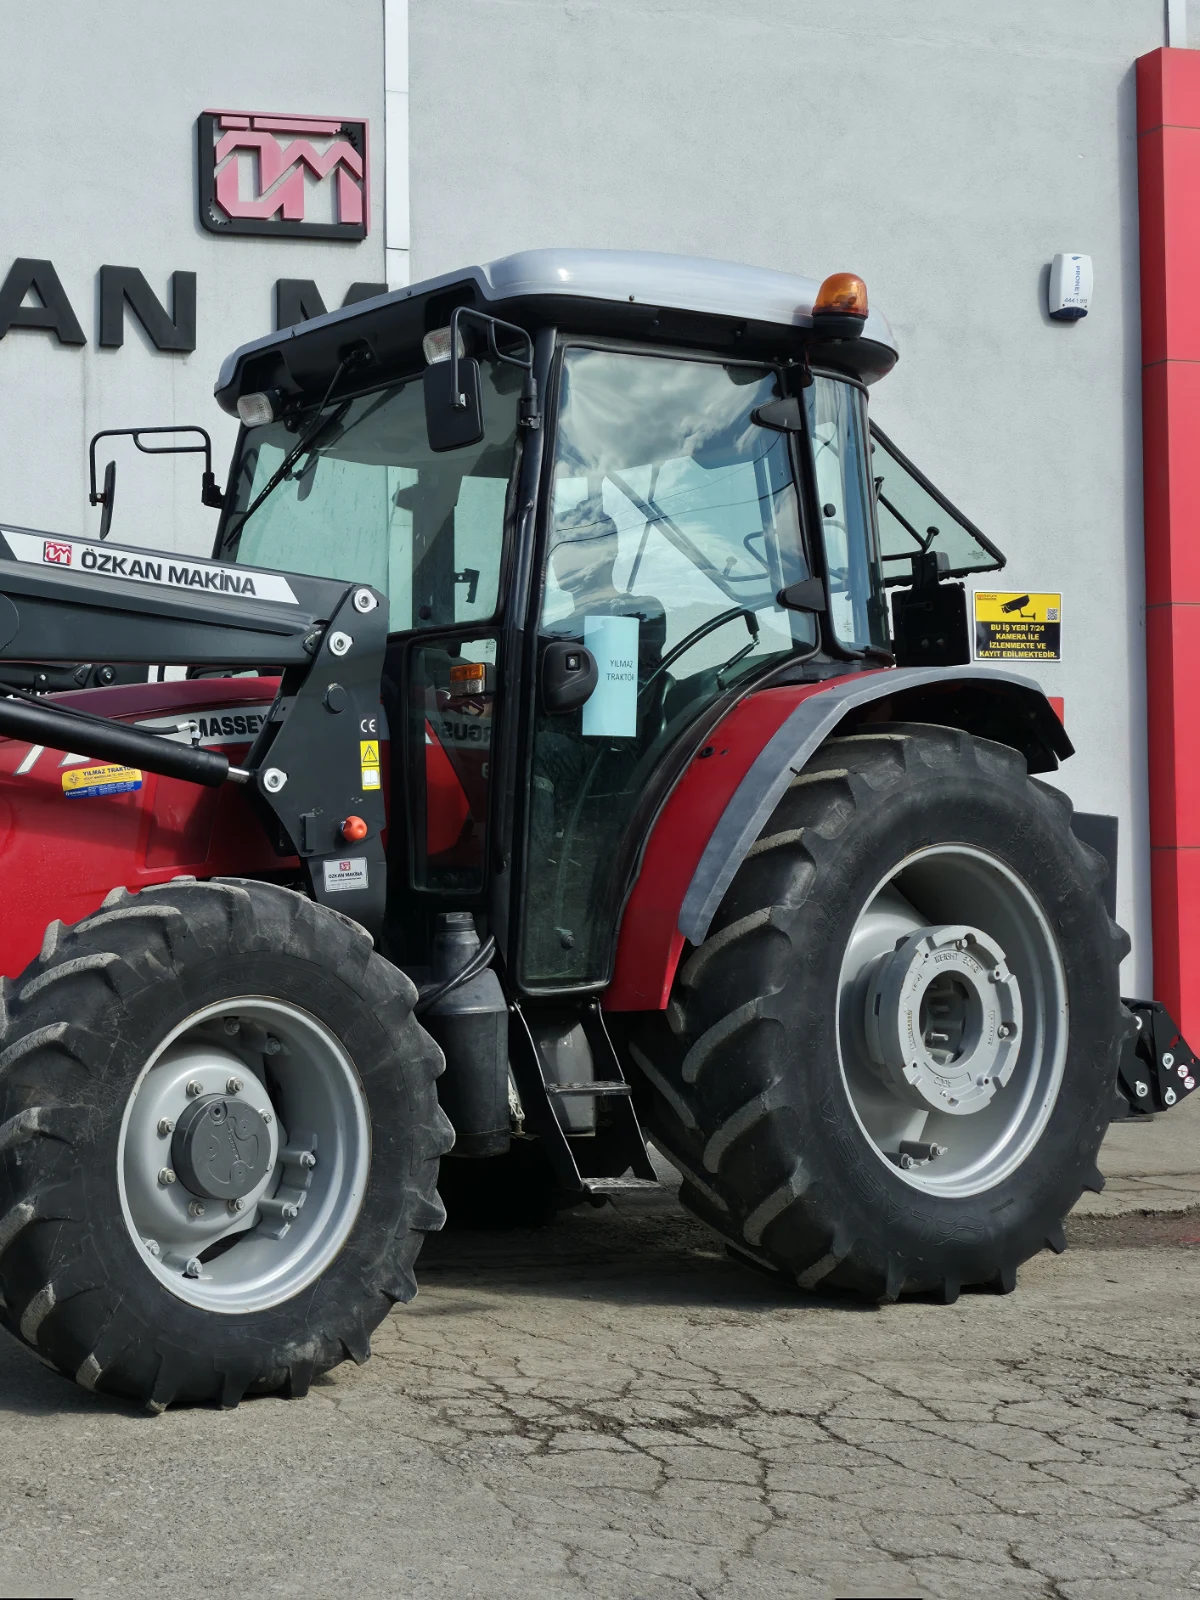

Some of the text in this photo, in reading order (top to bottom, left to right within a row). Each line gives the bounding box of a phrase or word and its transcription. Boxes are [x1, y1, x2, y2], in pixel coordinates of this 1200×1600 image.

[81, 548, 256, 596] ÖZKAN MAKİNA
[1003, 623, 1010, 632] İŞ
[1011, 623, 1028, 631] YERİ
[1028, 632, 1040, 640] İLE
[990, 641, 1035, 649] İZLENMEKTE
[609, 659, 634, 668] YILMAZ
[83, 768, 106, 776] YILMAZ
